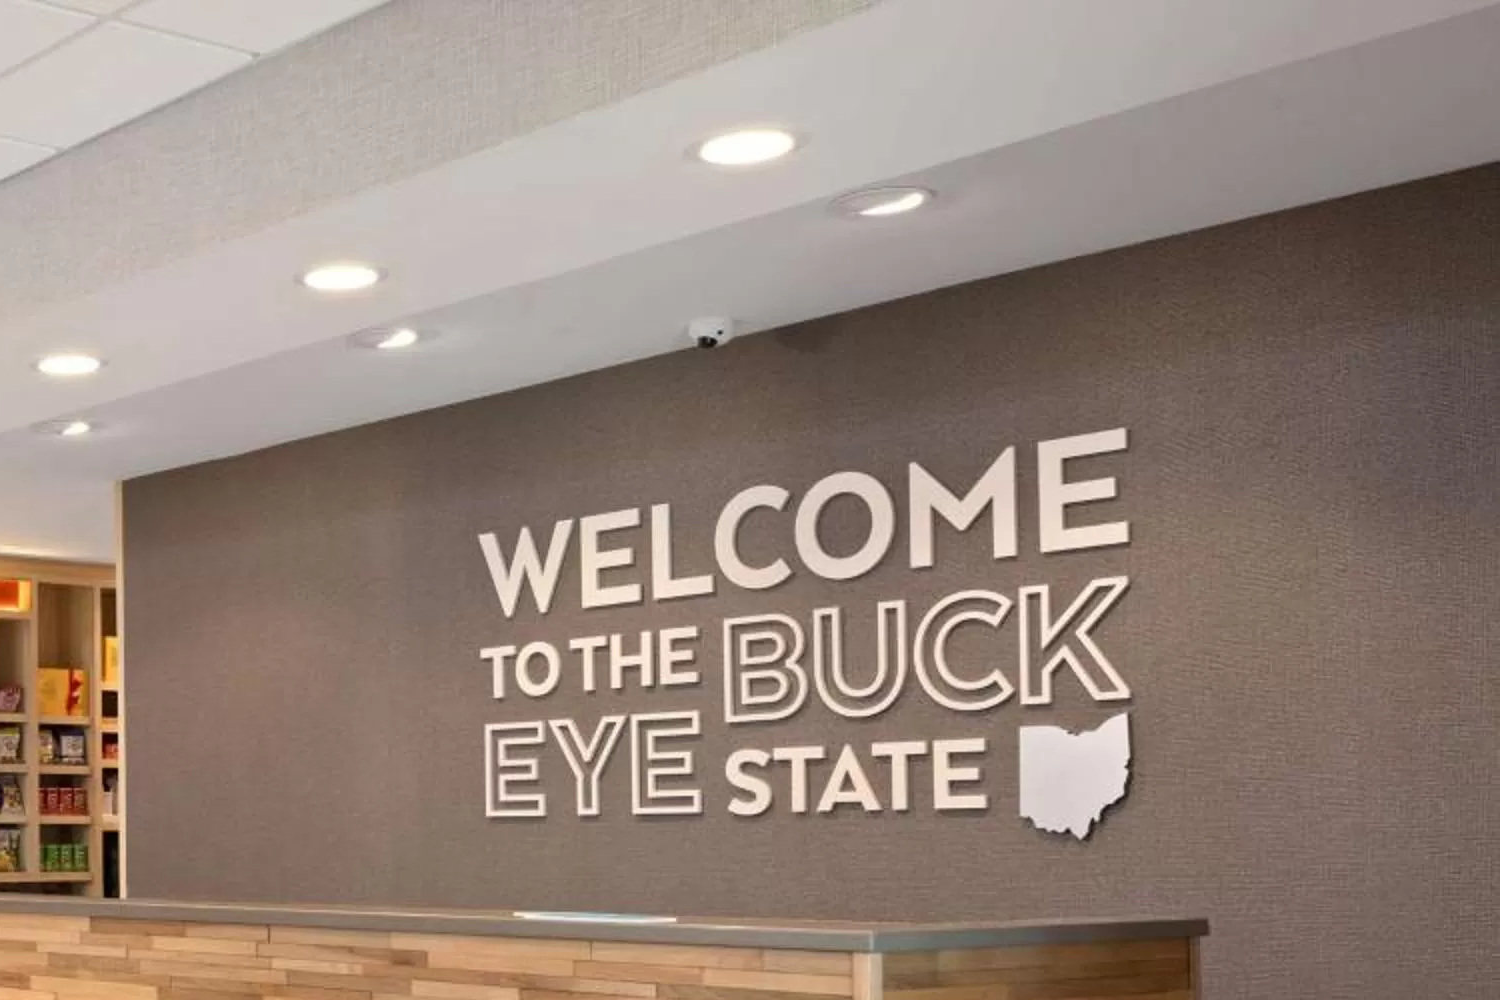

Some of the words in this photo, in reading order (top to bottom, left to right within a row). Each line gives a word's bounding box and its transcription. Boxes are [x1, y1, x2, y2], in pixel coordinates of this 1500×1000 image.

[478, 427, 1132, 618] WELCOME
[479, 640, 562, 699] TO
[569, 626, 701, 692] THE
[723, 575, 1132, 724] BUCK
[484, 710, 703, 818] EYE
[724, 737, 989, 817] STATE
